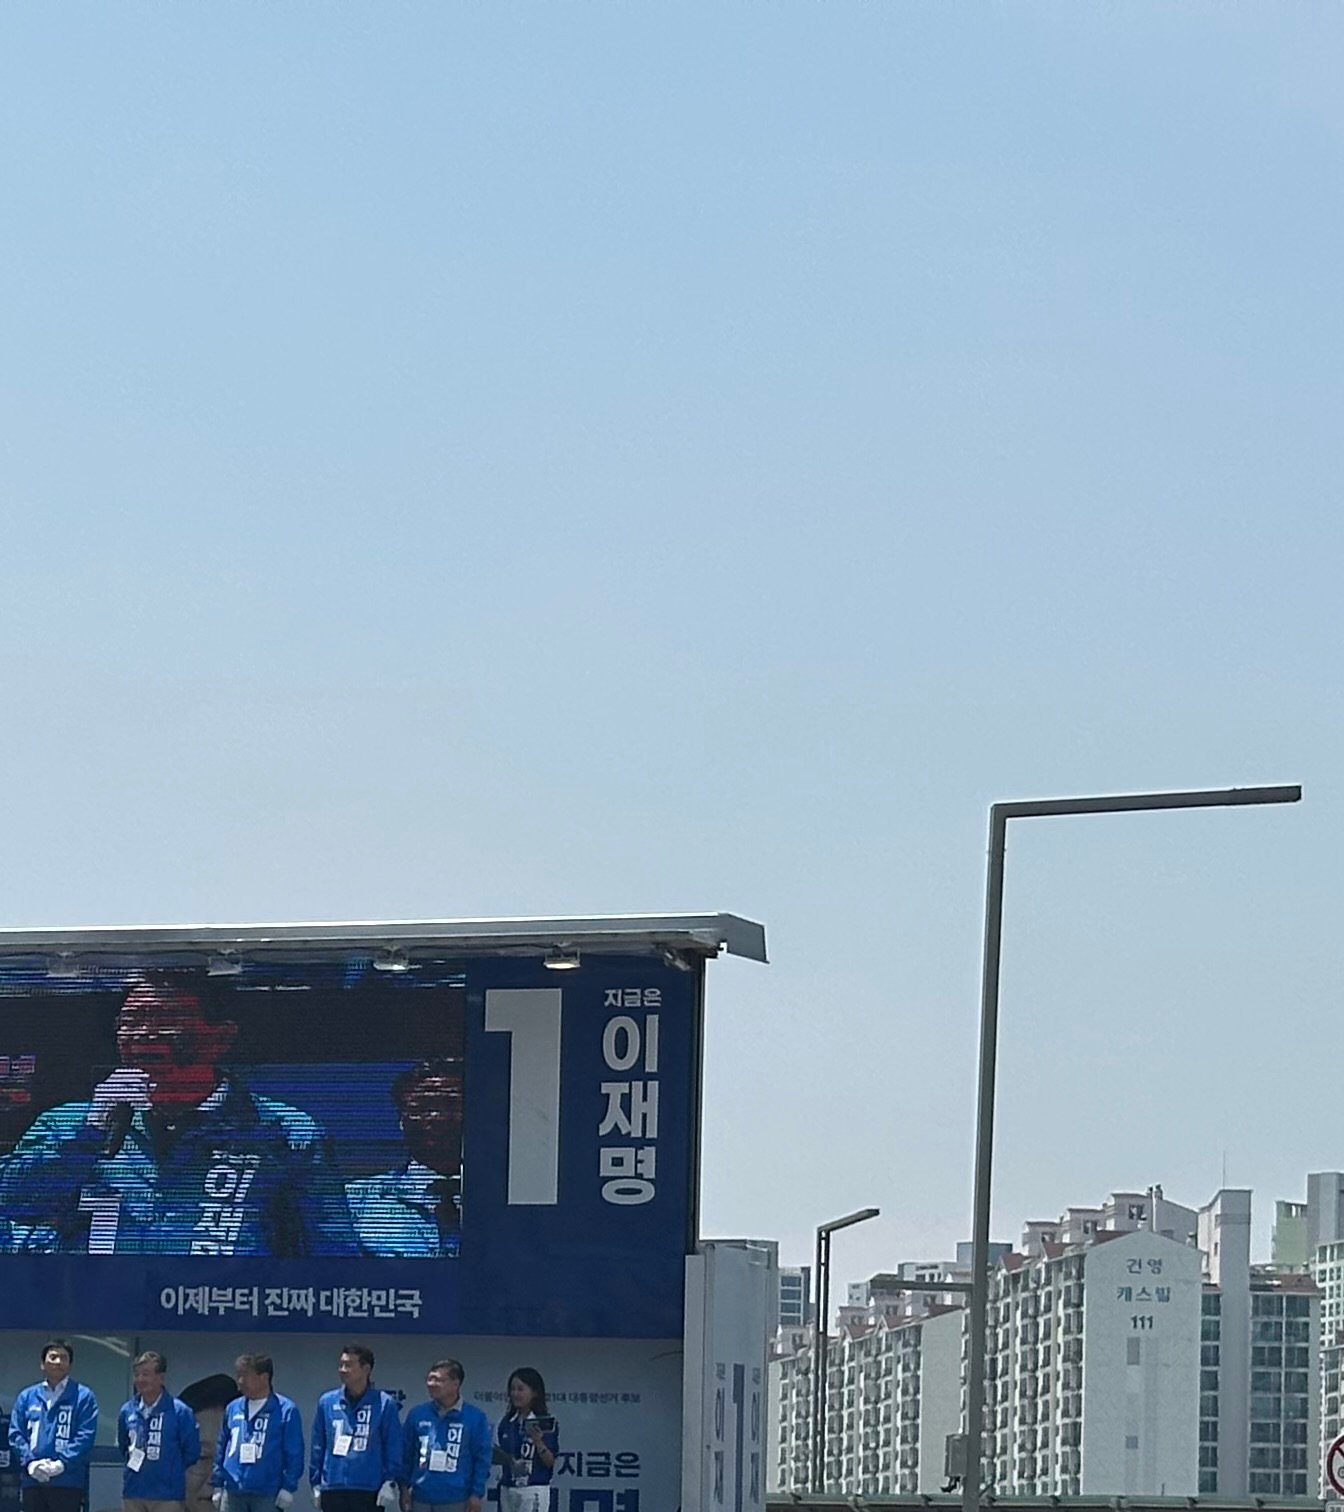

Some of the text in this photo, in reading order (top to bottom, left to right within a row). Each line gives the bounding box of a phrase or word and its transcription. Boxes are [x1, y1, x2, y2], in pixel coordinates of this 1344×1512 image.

[604, 989, 662, 1007] 지금은
[485, 988, 562, 1204] 1
[599, 1014, 659, 1205] 이재명
[160, 1286, 422, 1318] 이제부터 진짜 대한민국
[1131, 1315, 1153, 1329] 111
[558, 1452, 640, 1478] 지금은
